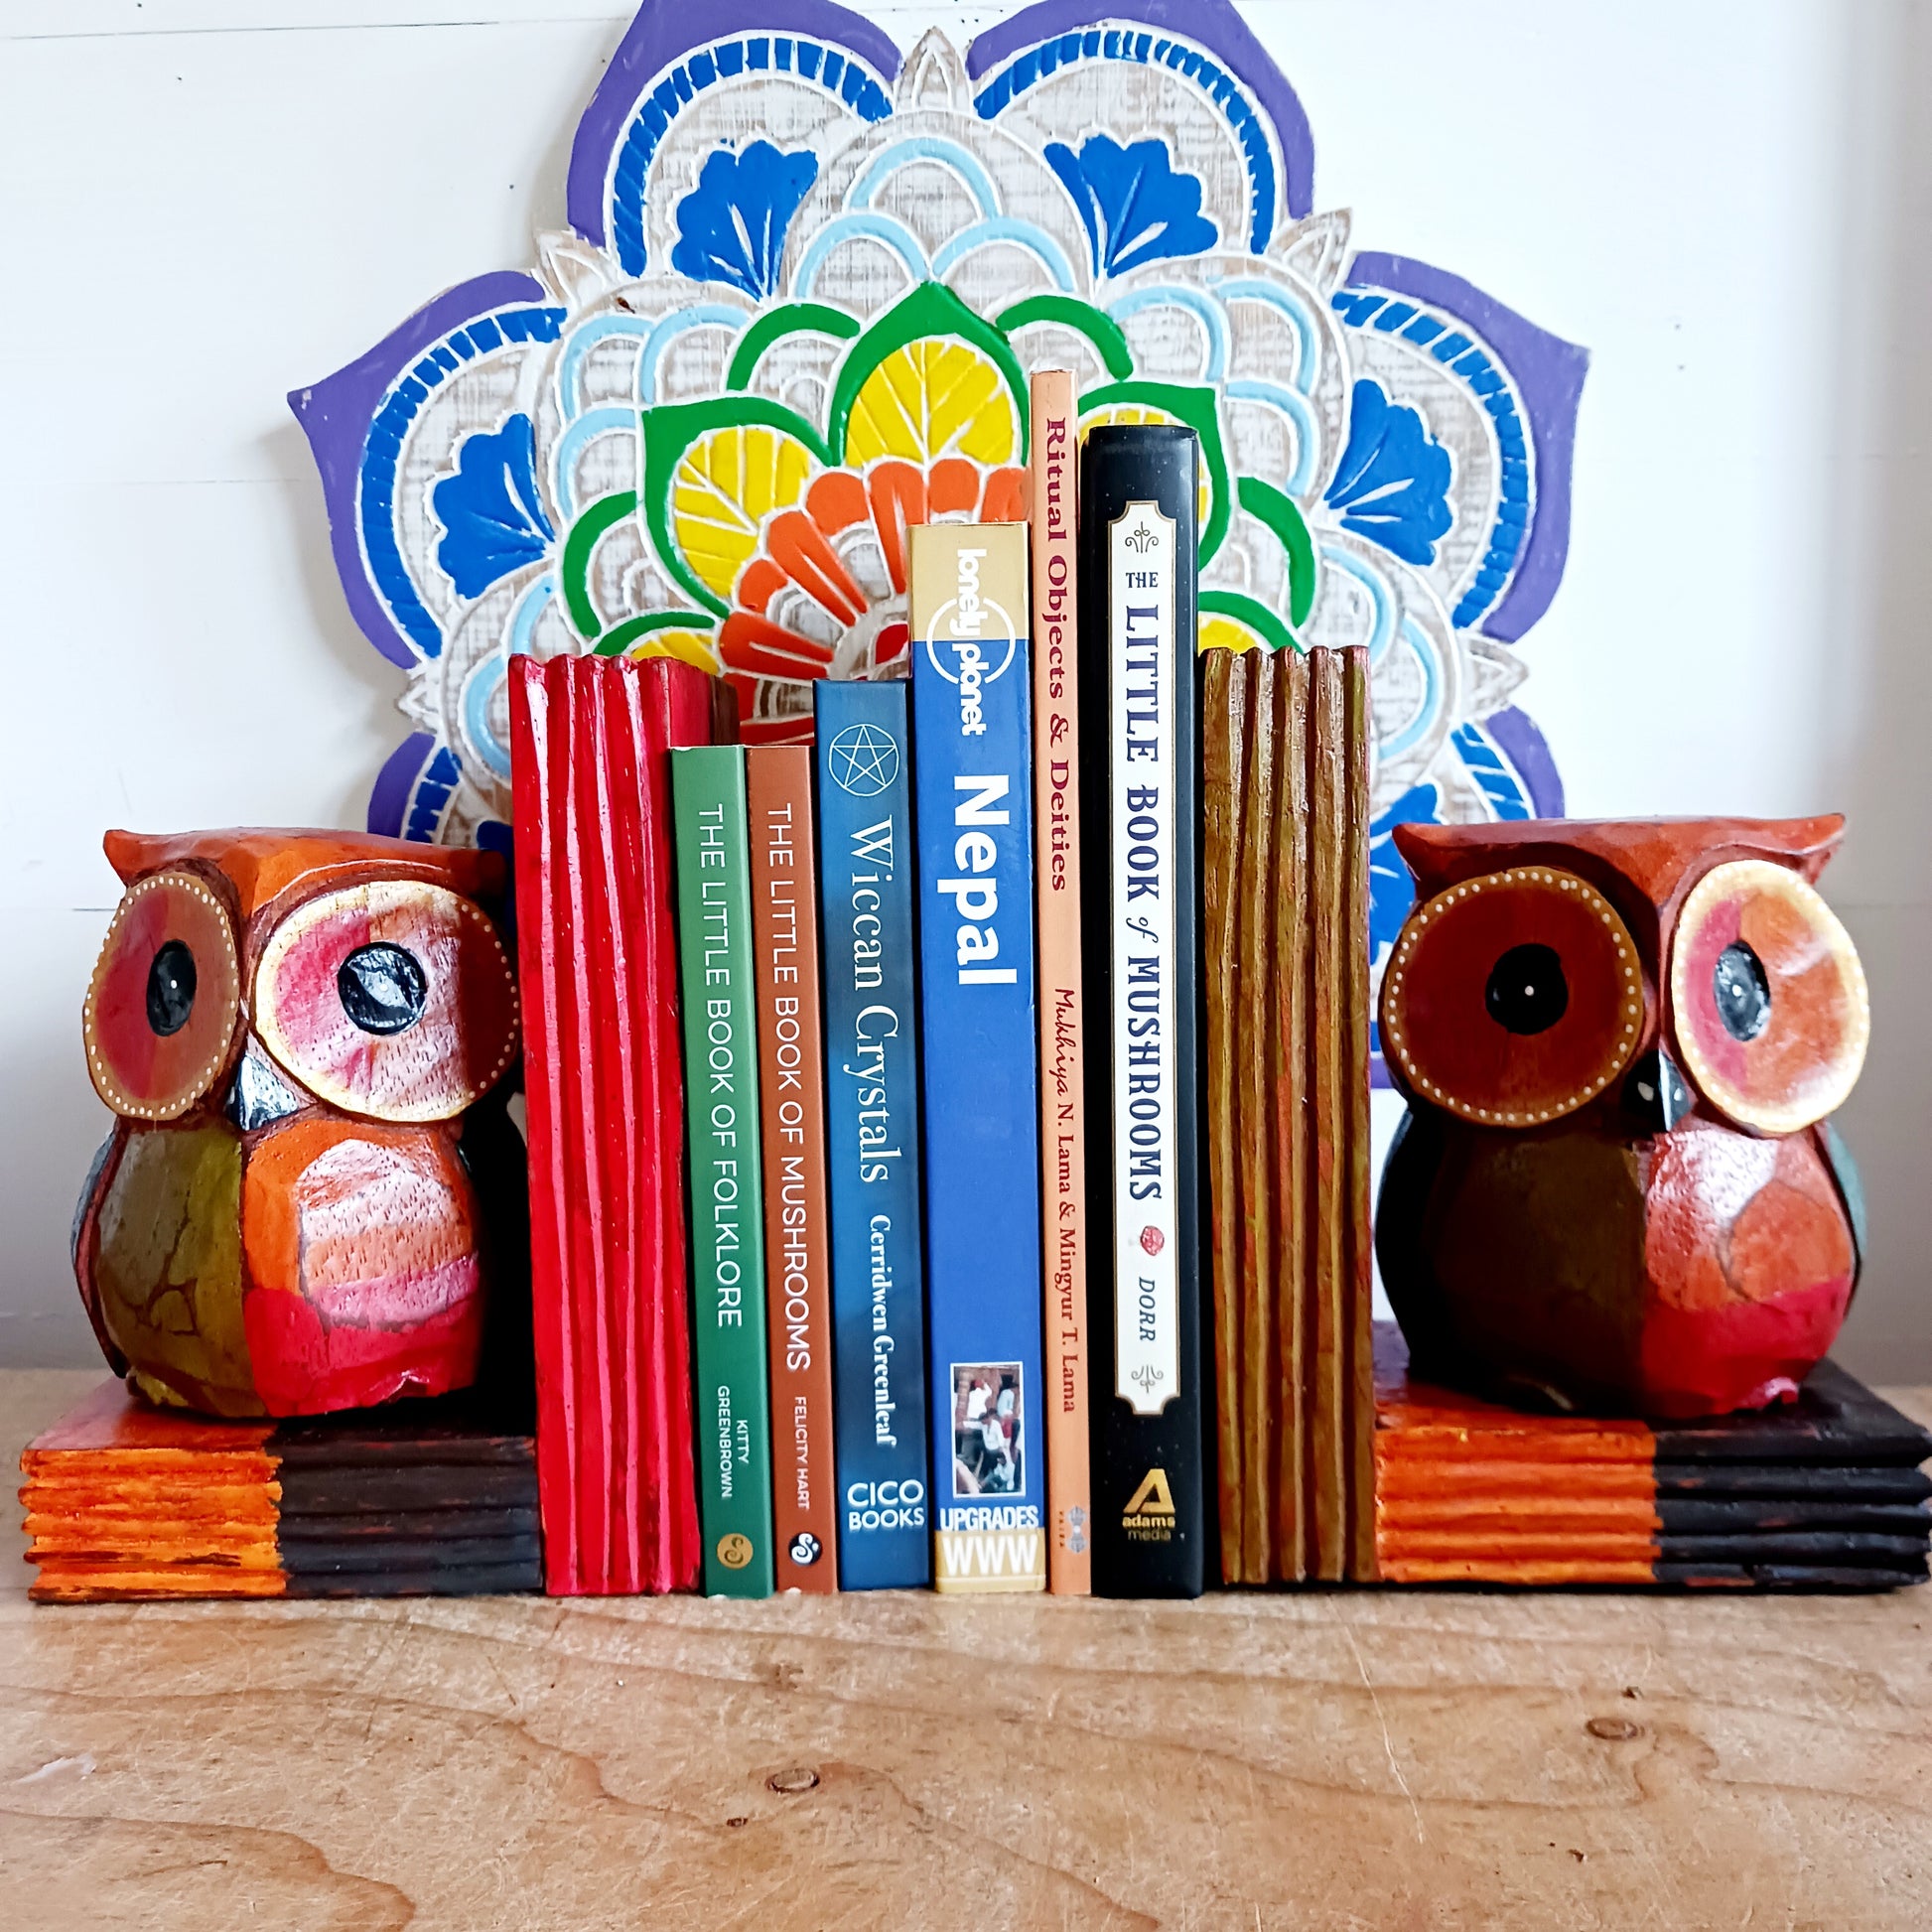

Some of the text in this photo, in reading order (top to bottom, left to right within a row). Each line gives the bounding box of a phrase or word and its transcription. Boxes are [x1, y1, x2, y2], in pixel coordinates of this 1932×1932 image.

[950, 549, 987, 736] lonely planet
[1042, 417, 1070, 892] Ritual Objects & Deities
[937, 774, 1018, 985] Nepal
[1125, 572, 1162, 1200] THE LITTLE BOOK of MUSHROOMS
[843, 815, 901, 1182] Wiccan Crystals
[698, 803, 743, 1327] THE LITTLE BOOK OF FOLKLORE
[767, 803, 811, 1372] THE LITTLE BOOK OF MUSHROOMS
[1048, 988, 1079, 1413] Mukhiya N. Lama & Mingyur T. Lama
[870, 1214, 897, 1449] Cerridwen Greenleaf
[1139, 1277, 1156, 1341] DORR
[718, 1385, 733, 1499] GREENBROWN
[736, 1420, 750, 1464] KITTY
[795, 1396, 810, 1510] FELICITY HART
[847, 1479, 924, 1507] CICO
[849, 1506, 924, 1530] BOOKS
[939, 1505, 1039, 1531] UPGRADES
[942, 1535, 1037, 1576] WWW
[1122, 1515, 1175, 1528] adams
[1128, 1528, 1171, 1541] media
